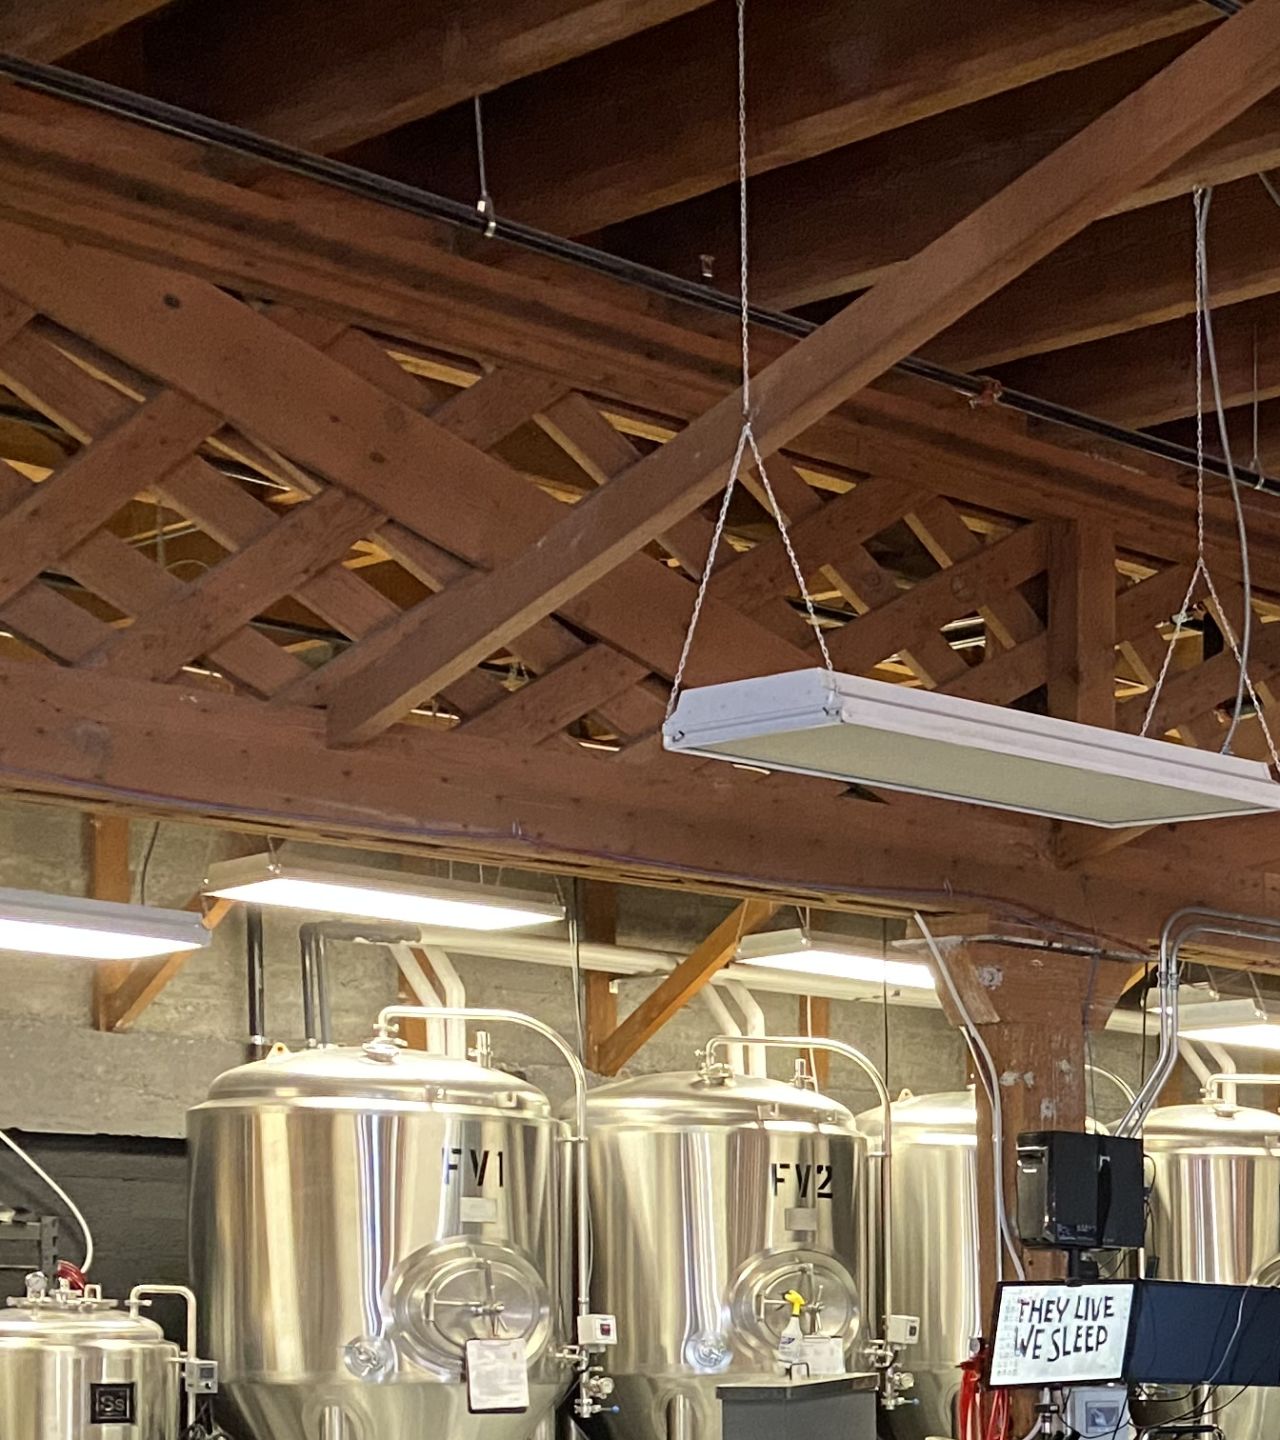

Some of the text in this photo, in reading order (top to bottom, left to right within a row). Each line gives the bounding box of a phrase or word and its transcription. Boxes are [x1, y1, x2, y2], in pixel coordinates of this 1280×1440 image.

[441, 1148, 504, 1187] FV1
[771, 1163, 833, 1199] FV2
[1018, 1295, 1115, 1324] THEY LIVE
[1014, 1324, 1046, 1360] WE
[1047, 1325, 1109, 1362] SLEEP
